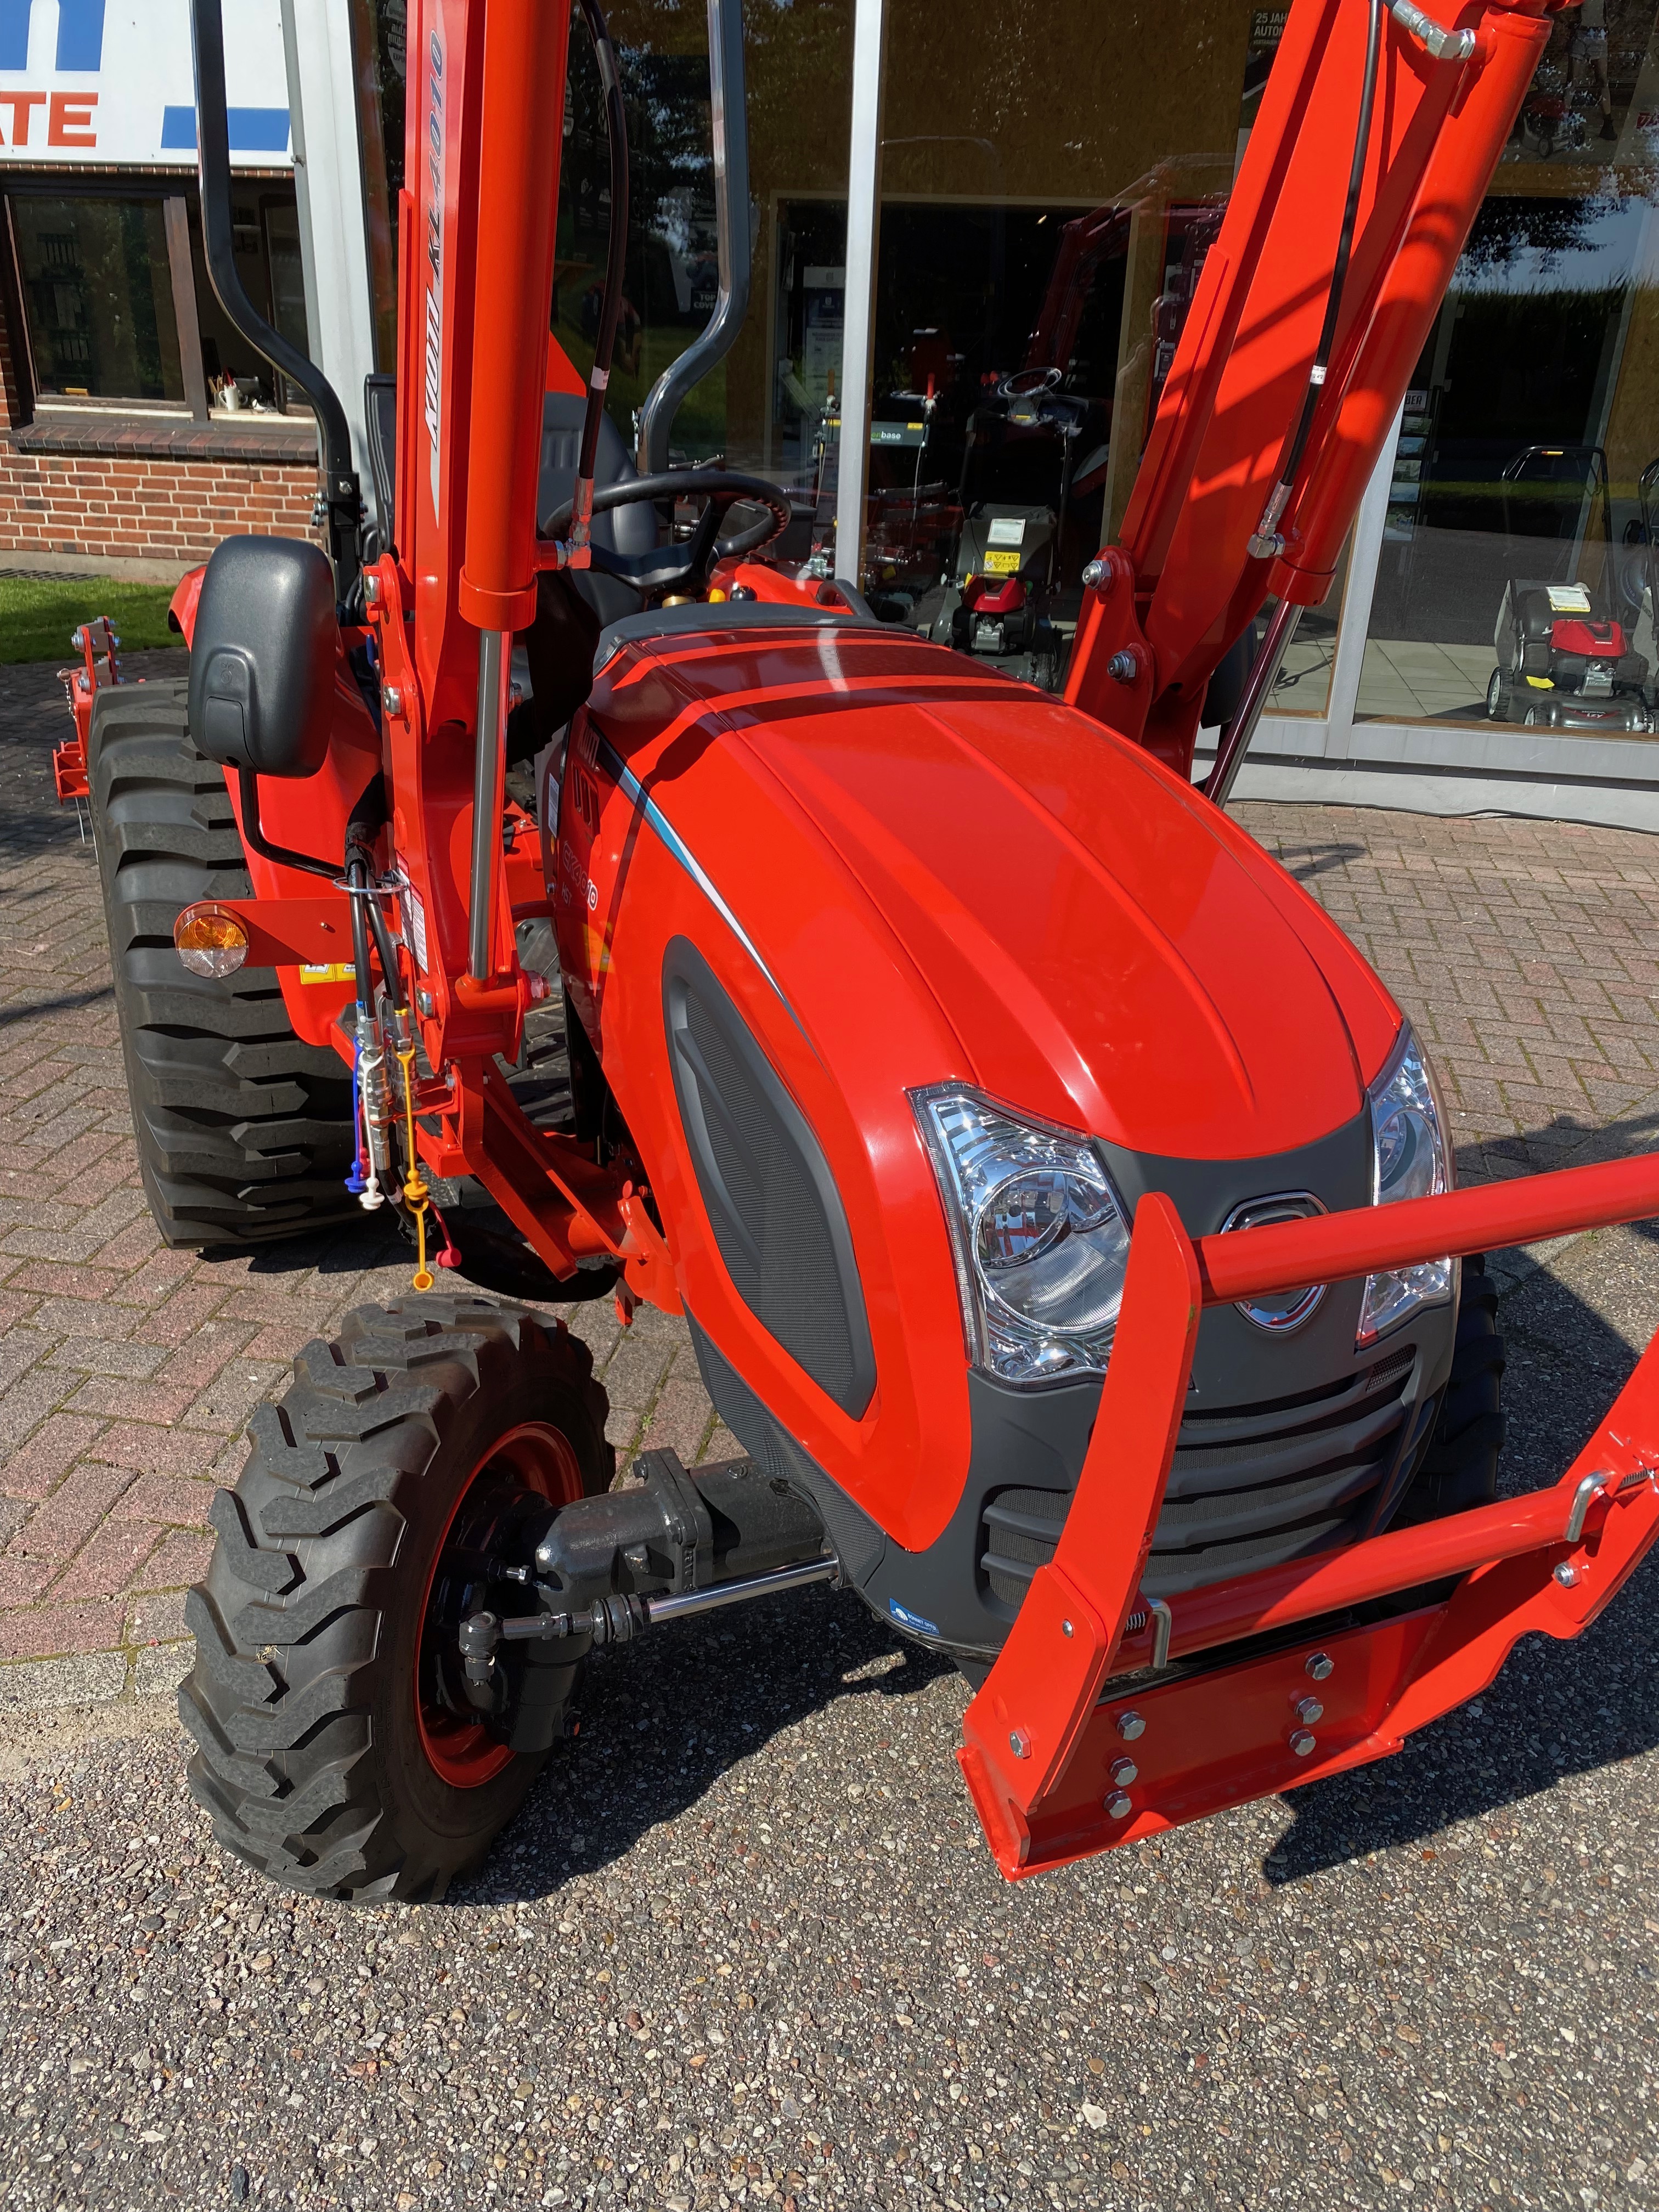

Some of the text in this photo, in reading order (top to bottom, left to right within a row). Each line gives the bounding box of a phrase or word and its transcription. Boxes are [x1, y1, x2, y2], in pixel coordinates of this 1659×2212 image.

[1255, 13, 1268, 24] 25
[0, 91, 99, 147] TE
[428, 29, 443, 285] KL4010
[562, 842, 599, 911] CK4010
[562, 882, 572, 908] HST
